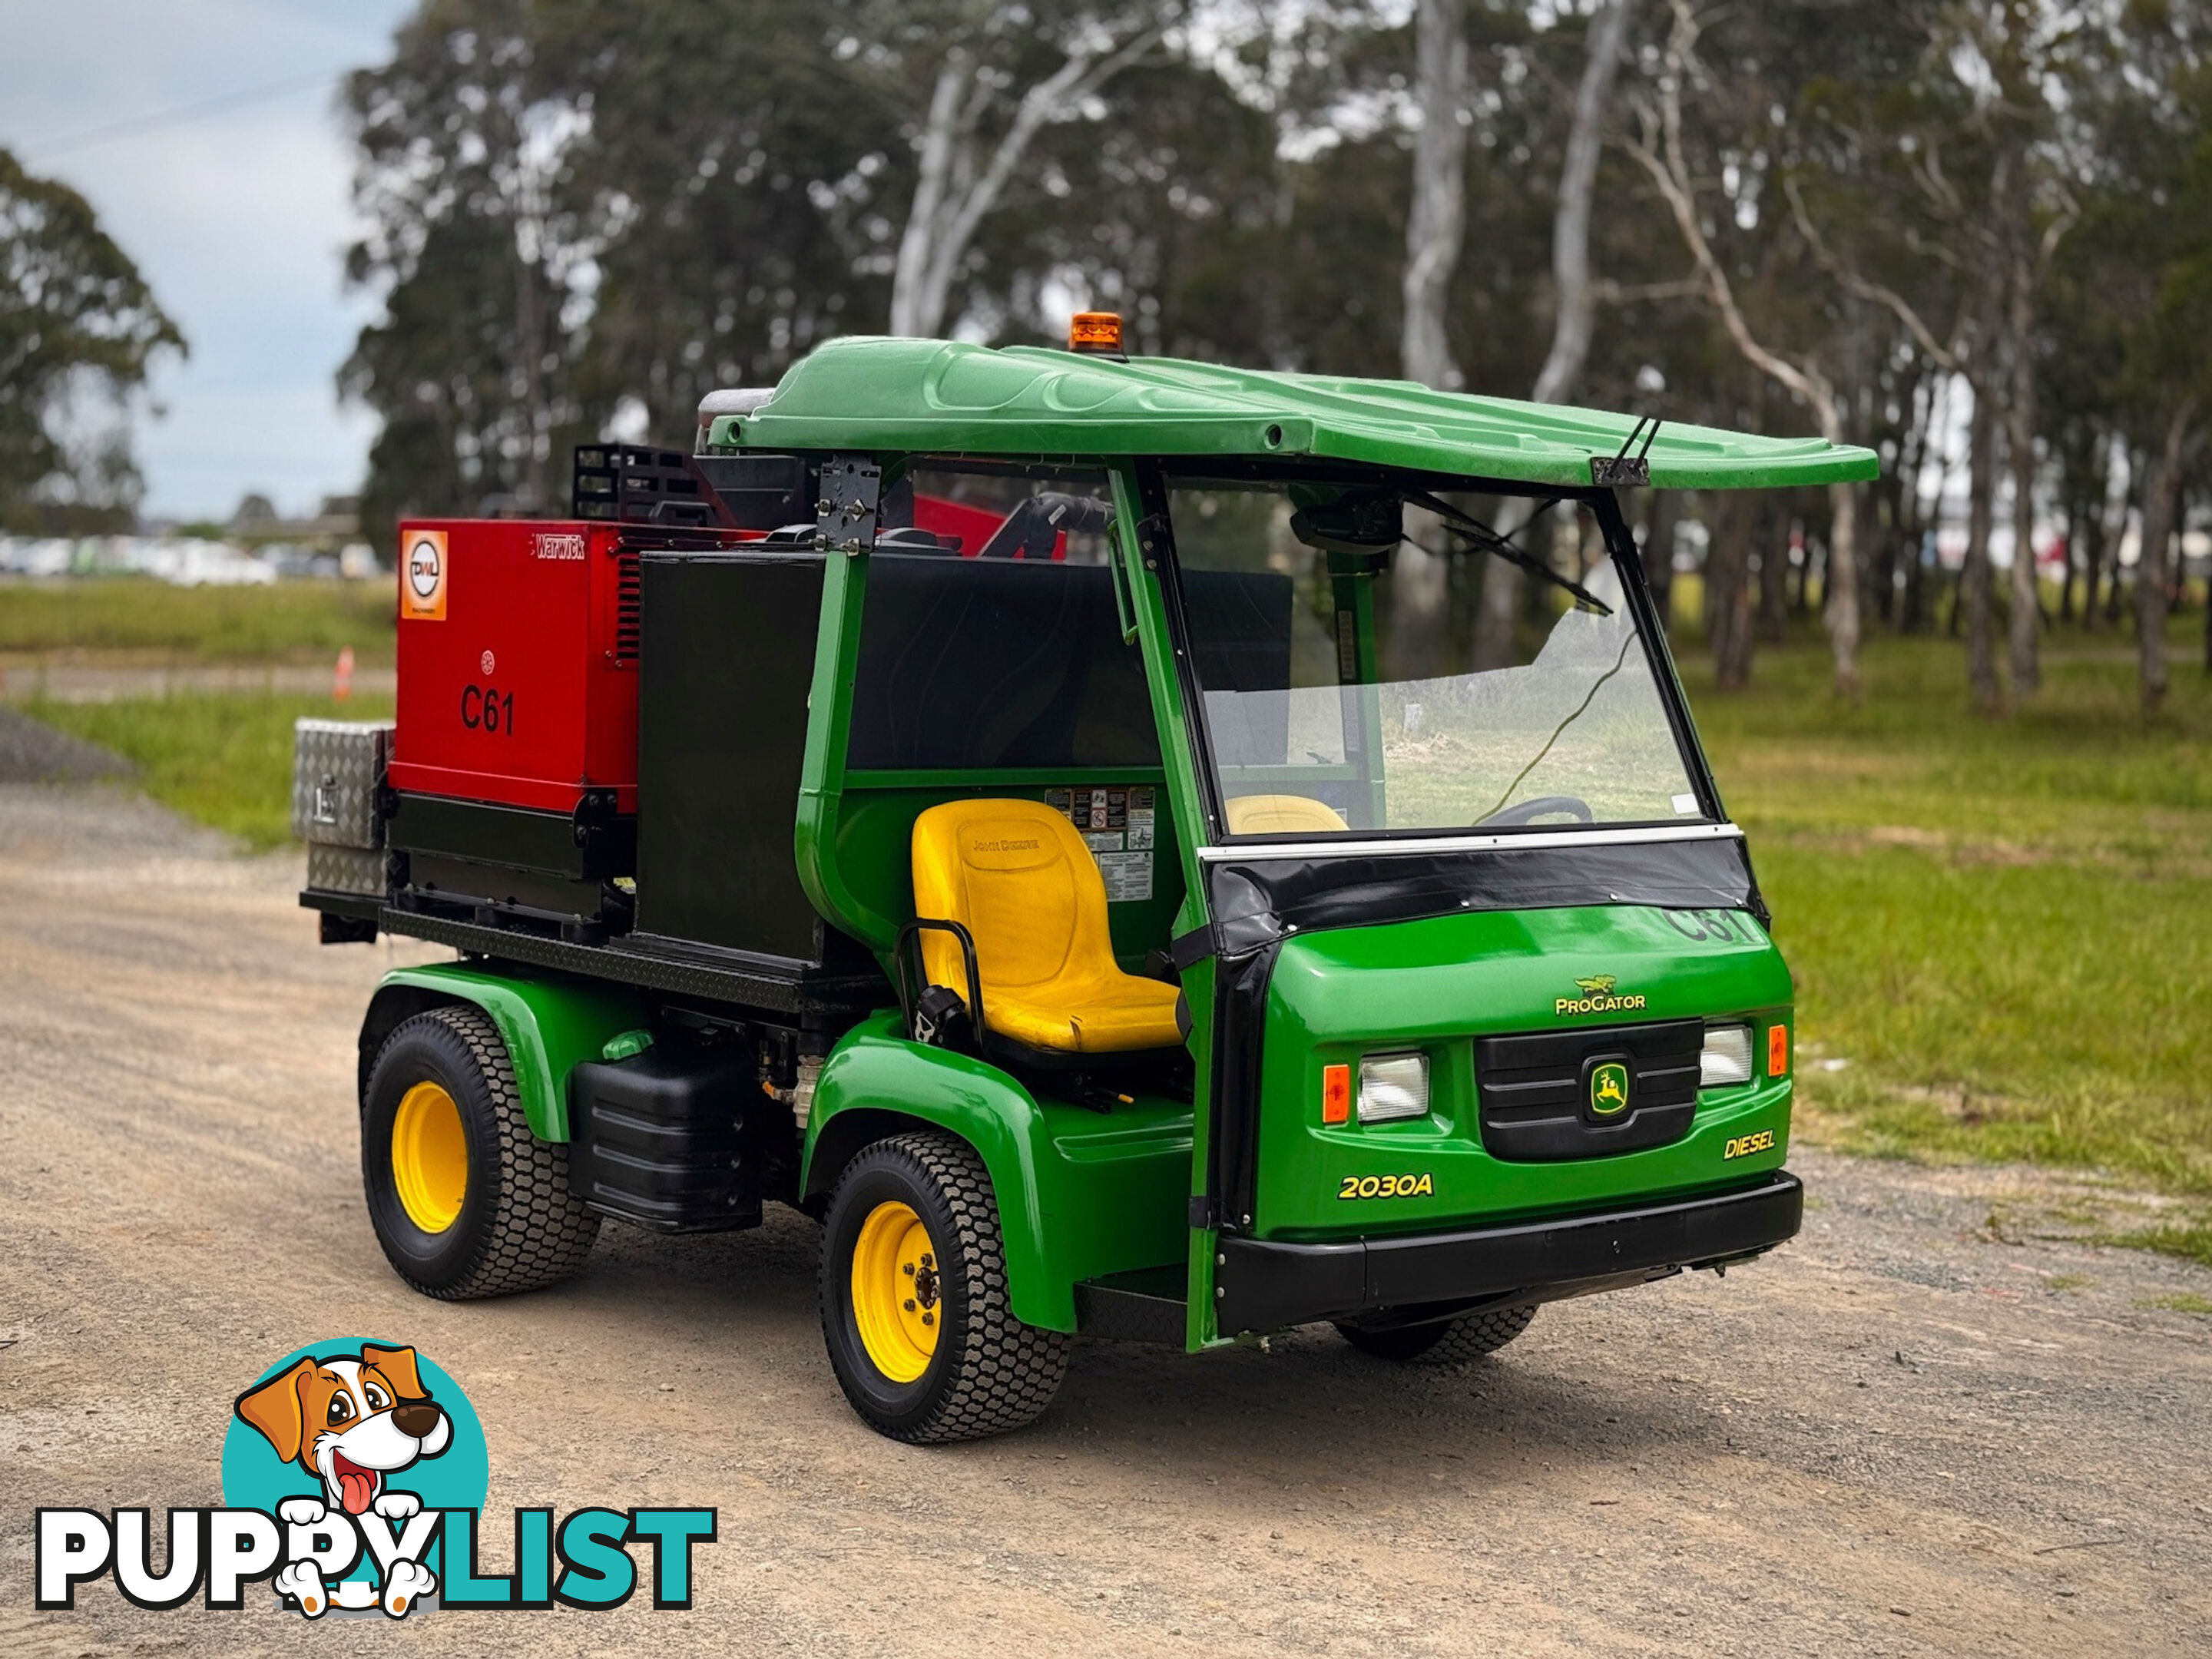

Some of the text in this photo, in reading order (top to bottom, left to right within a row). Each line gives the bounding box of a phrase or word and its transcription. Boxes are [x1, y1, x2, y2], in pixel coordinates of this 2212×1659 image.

[536, 533, 585, 560] Warwick
[462, 684, 514, 737] C61
[1661, 908, 1756, 943] C61
[1723, 1128, 1776, 1161] DIESEL
[1338, 1173, 1434, 1199] 2030A
